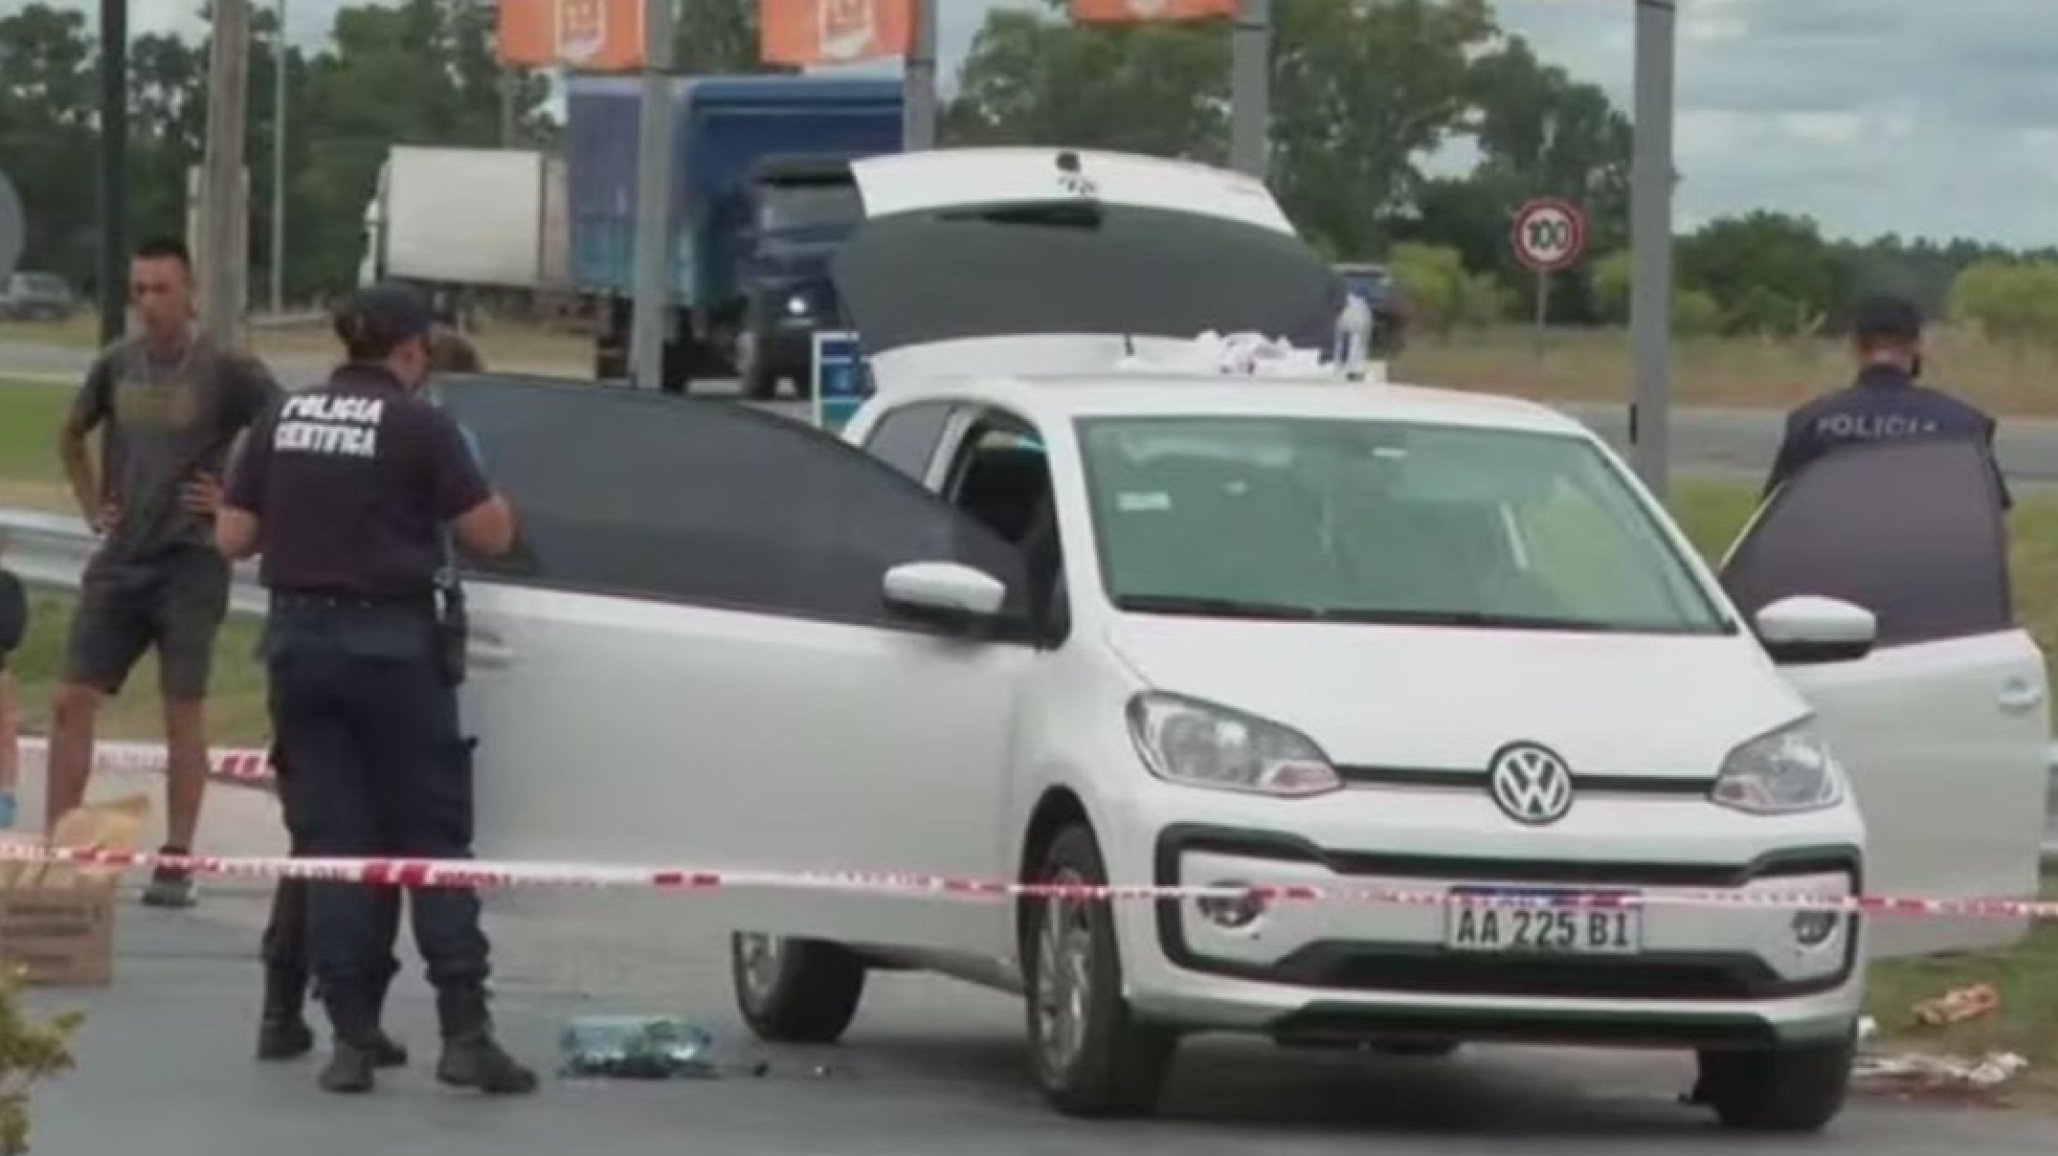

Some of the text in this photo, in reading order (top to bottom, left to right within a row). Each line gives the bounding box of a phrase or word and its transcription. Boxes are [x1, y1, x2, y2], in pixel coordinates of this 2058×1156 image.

[1528, 218, 1568, 251] 100
[1456, 908, 1500, 944] AA
[1512, 909, 1577, 946] 225
